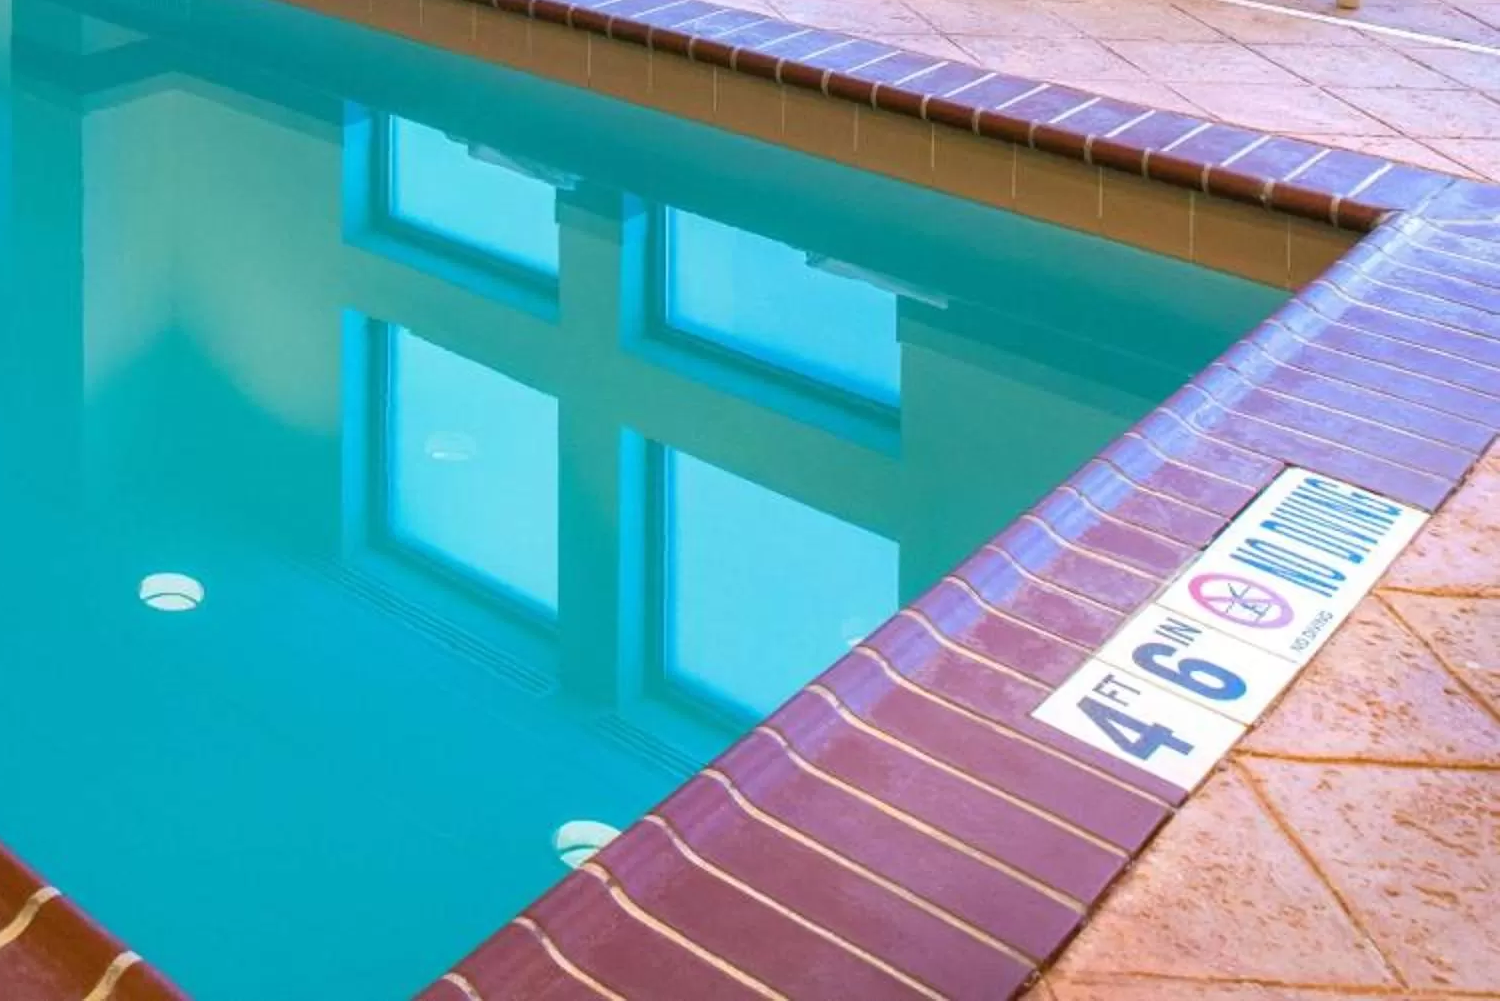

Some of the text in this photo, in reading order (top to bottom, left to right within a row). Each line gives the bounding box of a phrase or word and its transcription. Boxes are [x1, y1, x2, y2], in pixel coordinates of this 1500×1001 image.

[1230, 477, 1402, 597] NO DIVING
[1076, 617, 1247, 760] 4 FT 6 IN
[1289, 610, 1333, 651] NO DIVING
